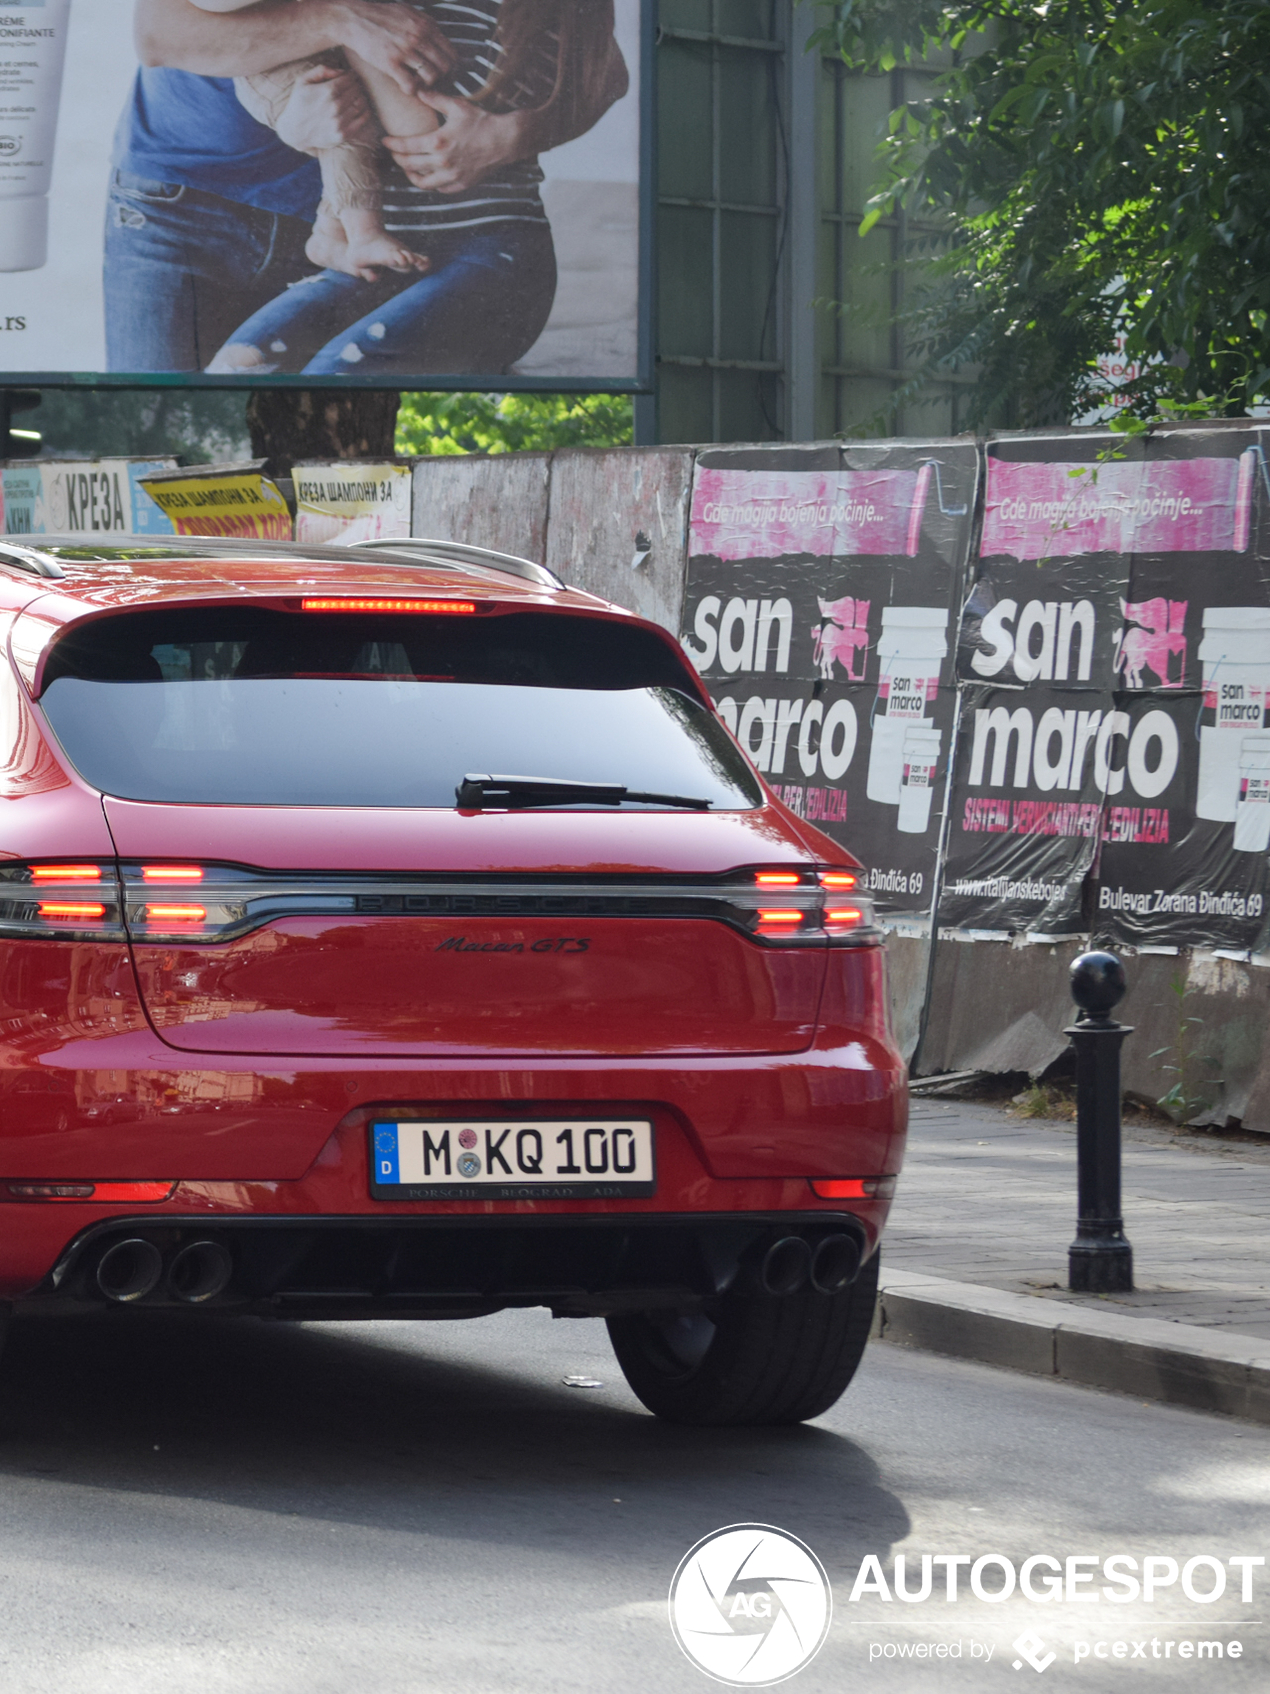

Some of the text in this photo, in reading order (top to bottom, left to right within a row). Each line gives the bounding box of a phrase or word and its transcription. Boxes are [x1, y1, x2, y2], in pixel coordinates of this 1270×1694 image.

[66, 472, 125, 531] КРЕЗА
[299, 480, 393, 502] КРЕЗА ШАМПОНИ ЗА
[703, 501, 729, 523] Gde
[730, 499, 777, 528] magija
[1000, 497, 1027, 520] Gde
[694, 595, 793, 673] san
[970, 598, 1096, 681] san
[893, 677, 911, 692] san
[1221, 683, 1244, 700] san
[890, 694, 923, 711] marco
[1220, 703, 1260, 720] marco
[968, 706, 1179, 798] marco
[909, 774, 927, 784] marco
[910, 765, 921, 773] san
[962, 797, 1011, 833] SISTEMI
[870, 867, 907, 893] Đinđića
[909, 872, 923, 894] 69
[1099, 886, 1263, 917] Bulevar Zorana Đinđića 69
[434, 936, 592, 953] Macan GTS
[381, 1128, 636, 1176] D M KQ 100
[409, 1187, 623, 1198] PORSCHE BEOGRAD ADA
